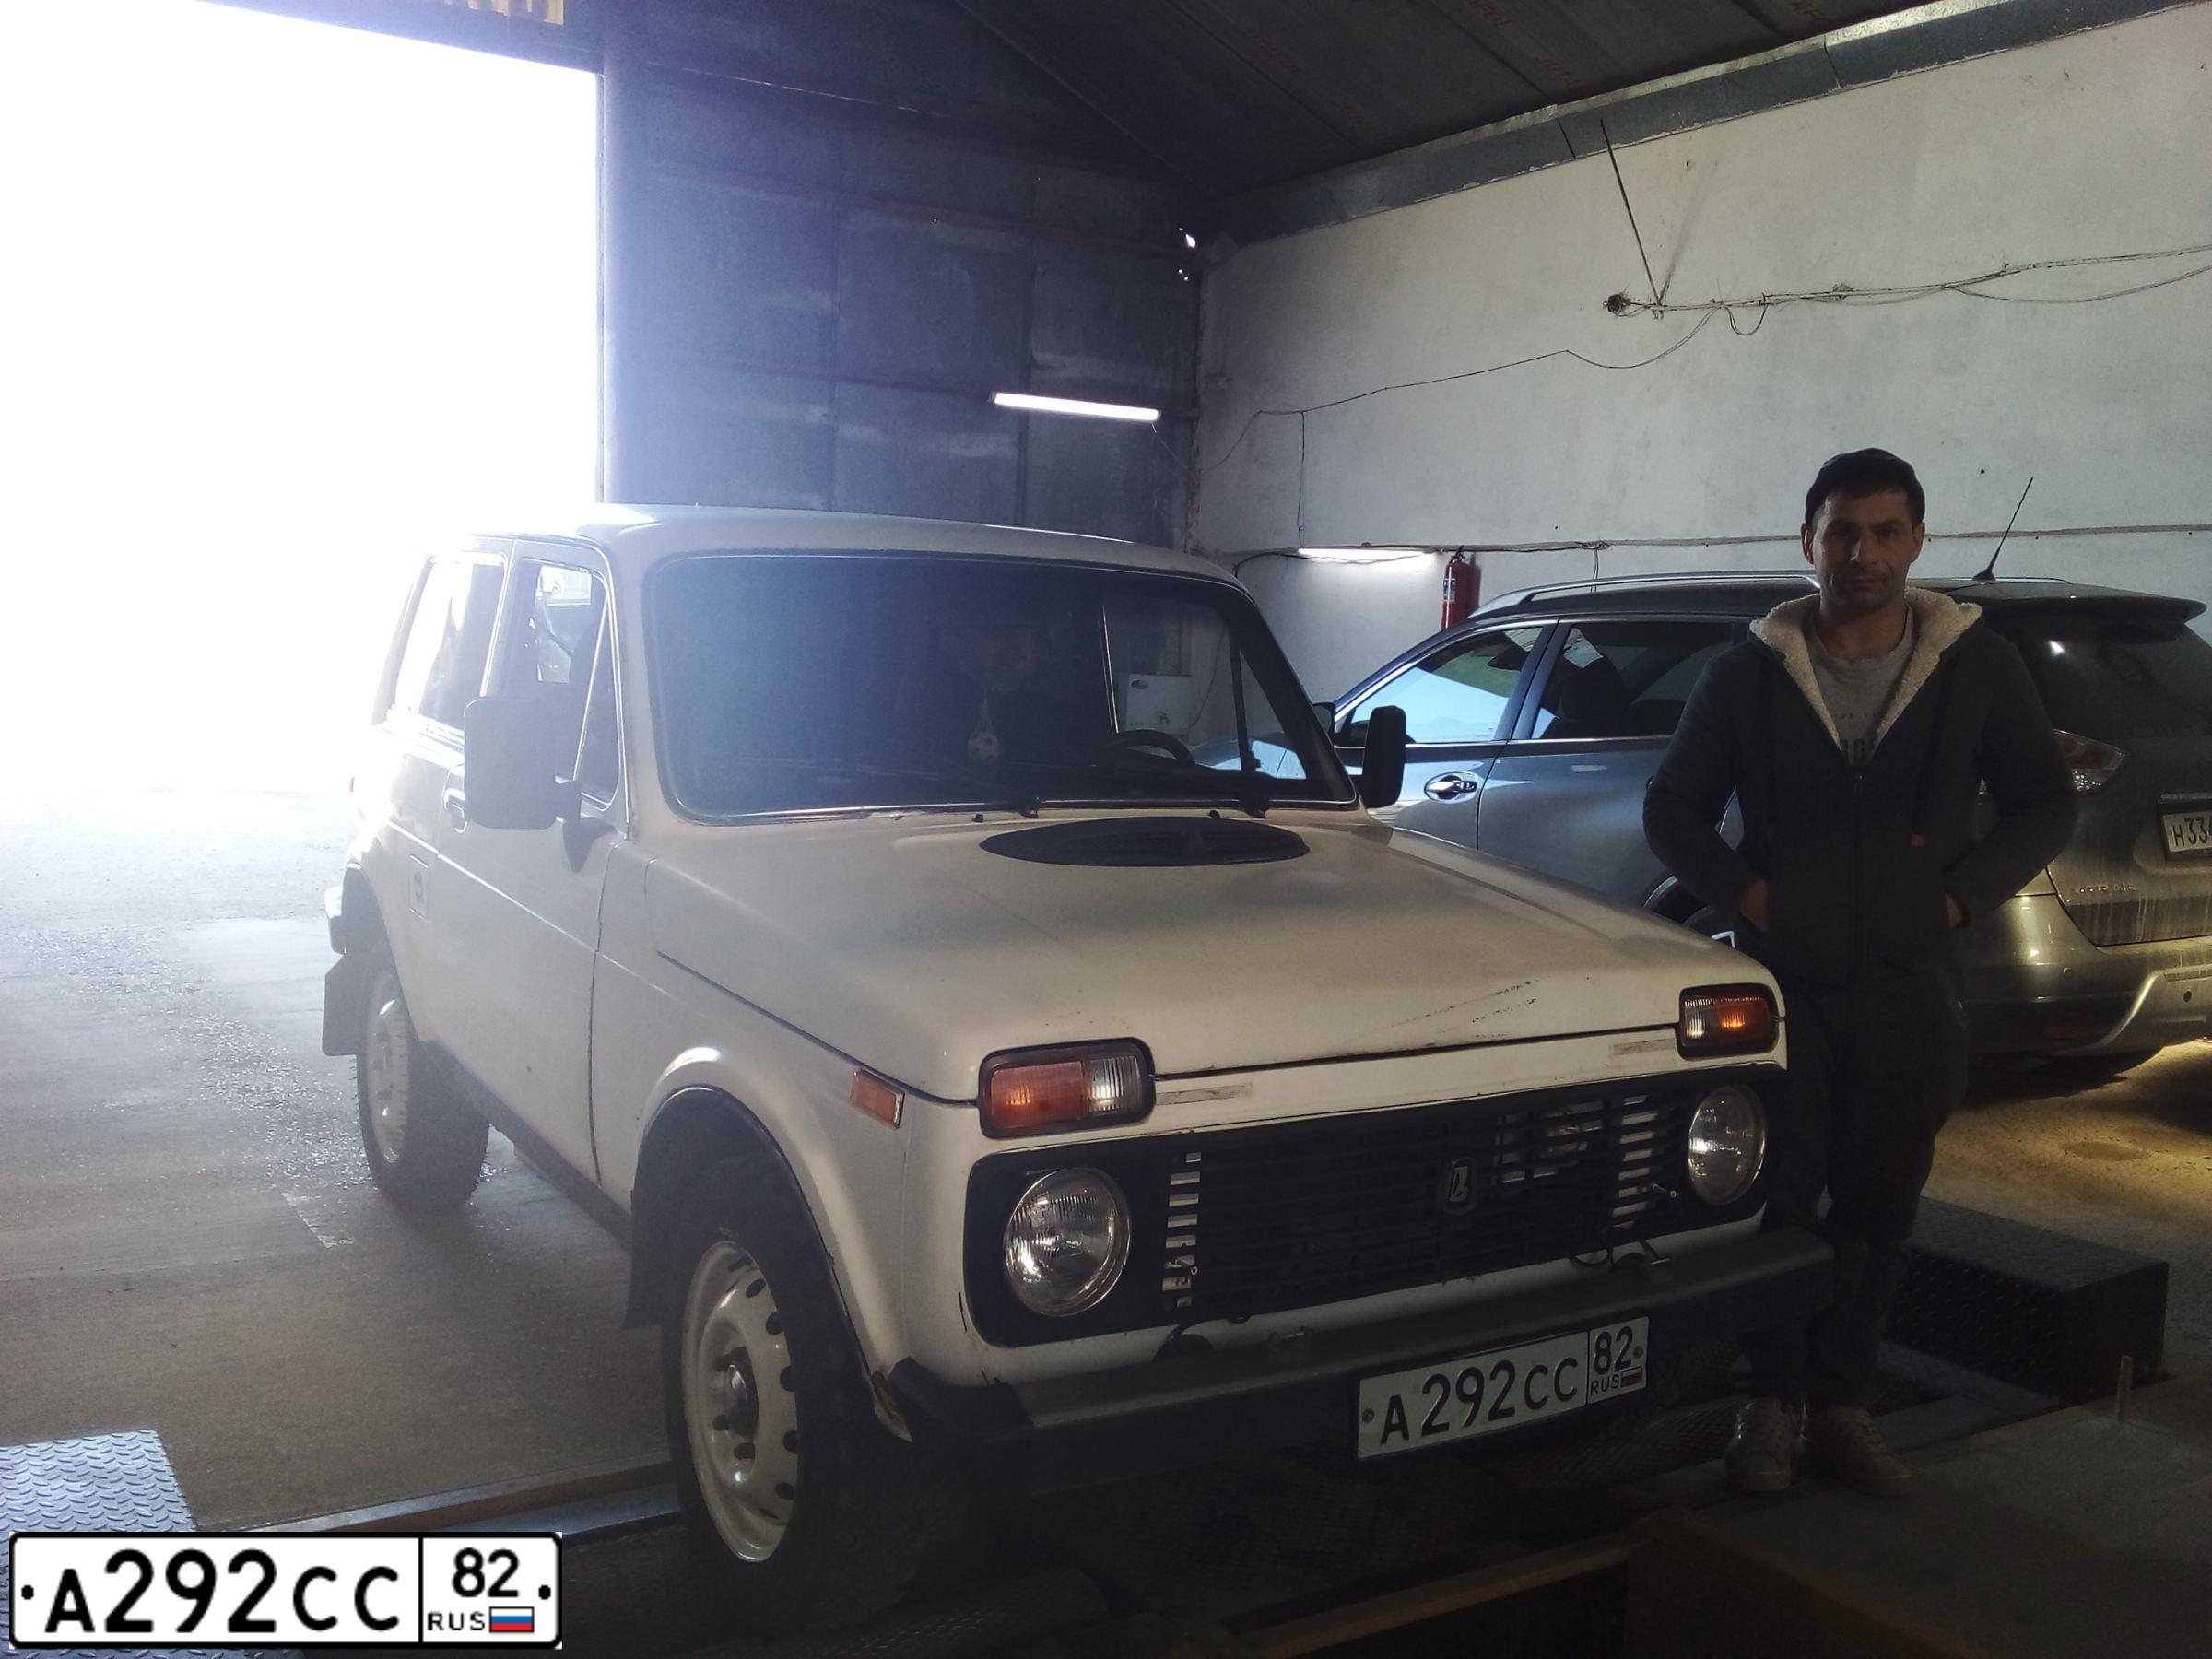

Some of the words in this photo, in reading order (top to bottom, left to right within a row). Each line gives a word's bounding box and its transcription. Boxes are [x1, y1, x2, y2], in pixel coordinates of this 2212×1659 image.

[2172, 816, 2212, 847] H33
[1379, 1357, 1579, 1445] A292CC
[1593, 1325, 1634, 1376] 82
[1589, 1372, 1620, 1397] RUS
